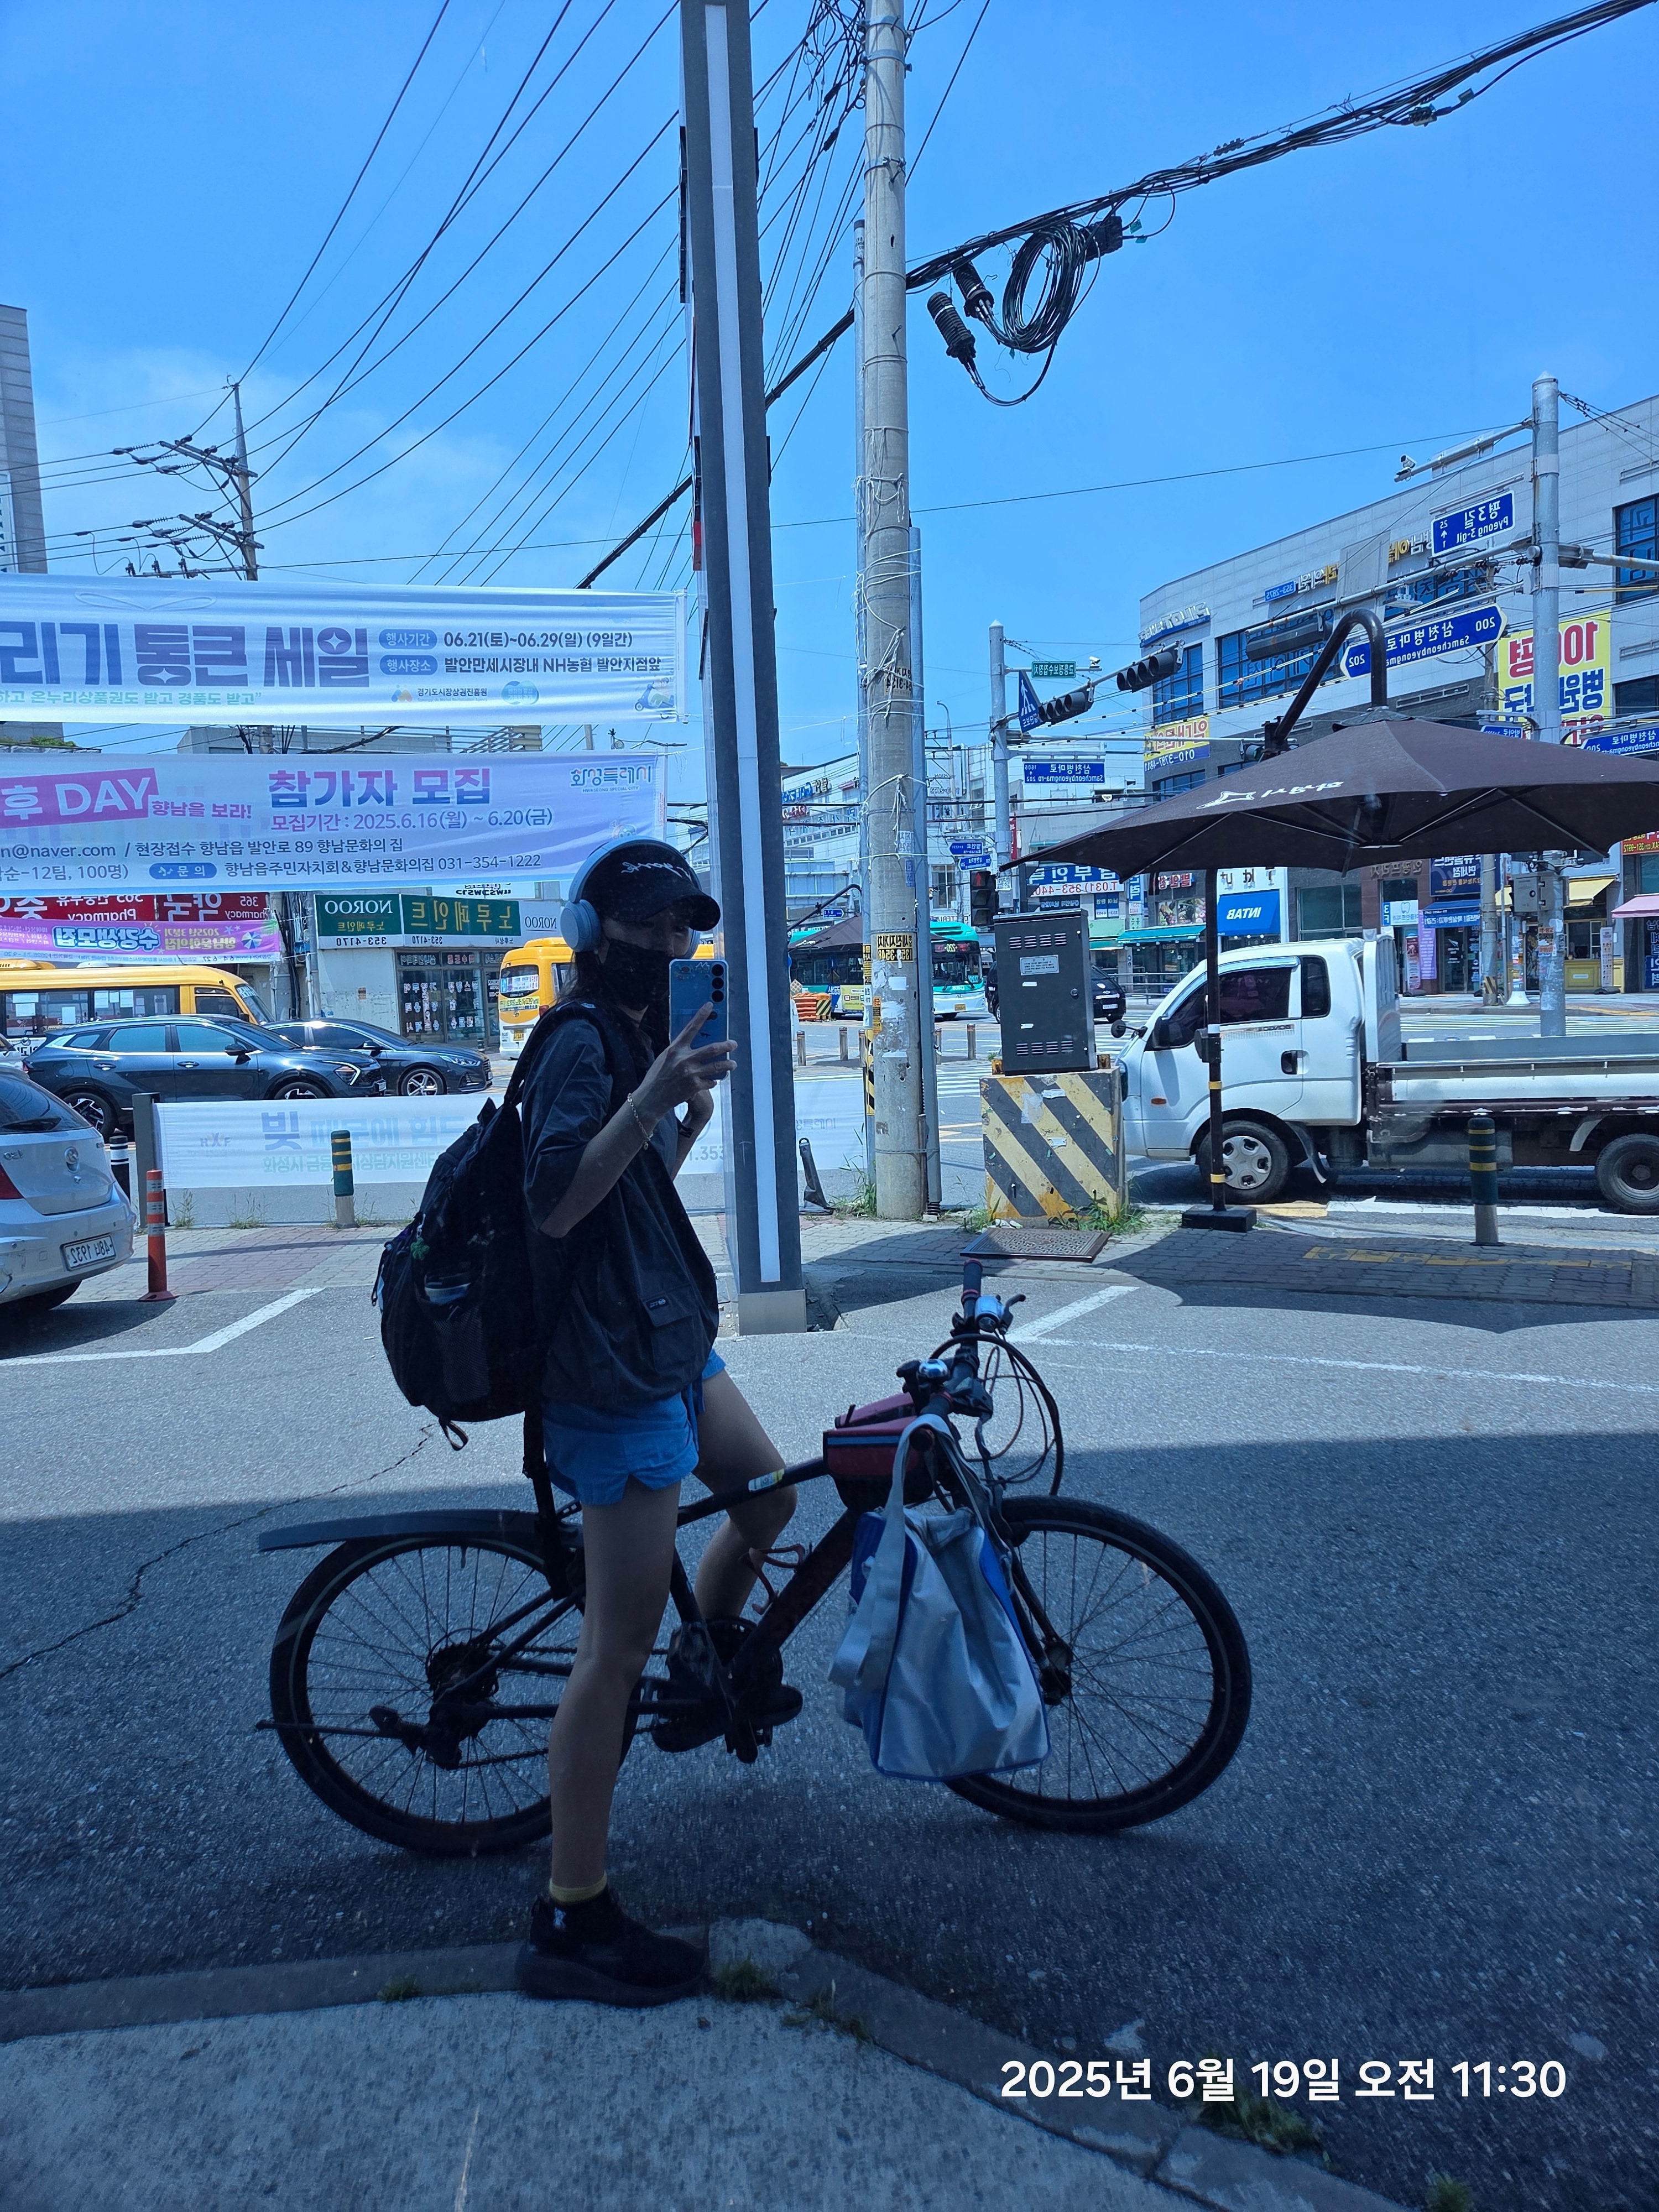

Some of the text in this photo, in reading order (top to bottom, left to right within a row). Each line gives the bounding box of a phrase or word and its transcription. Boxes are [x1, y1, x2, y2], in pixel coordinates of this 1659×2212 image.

[385, 633, 430, 647] 행사기간
[586, 632, 633, 648] (9일간)
[133, 623, 249, 687] 통큰
[263, 626, 370, 687] 세일
[385, 658, 431, 673] 행사장소
[444, 656, 661, 674] 발안만세시장내 NH농협 발안지점앞
[30, 690, 139, 705] 온누리상품권도
[144, 691, 173, 705] 받고
[178, 692, 221, 706] 경품도
[417, 687, 488, 697] 경기도시장상권진흥원
[571, 765, 651, 786] 화성특례시
[55, 777, 152, 817] DAY
[269, 768, 491, 808] 참가자 모집
[152, 800, 252, 819] 향남을 보라!
[271, 813, 341, 832] 모집기간
[353, 810, 467, 831] 2025.6.16(월)
[488, 806, 553, 829] 6.20(금)
[134, 842, 196, 858] 현장접수
[199, 841, 244, 855] 향남읍
[248, 841, 290, 855] 발안로
[295, 841, 314, 853] 89
[316, 838, 387, 854] 향남문화의
[437, 854, 542, 870] 031-354-1222
[77, 864, 129, 881] 100명)
